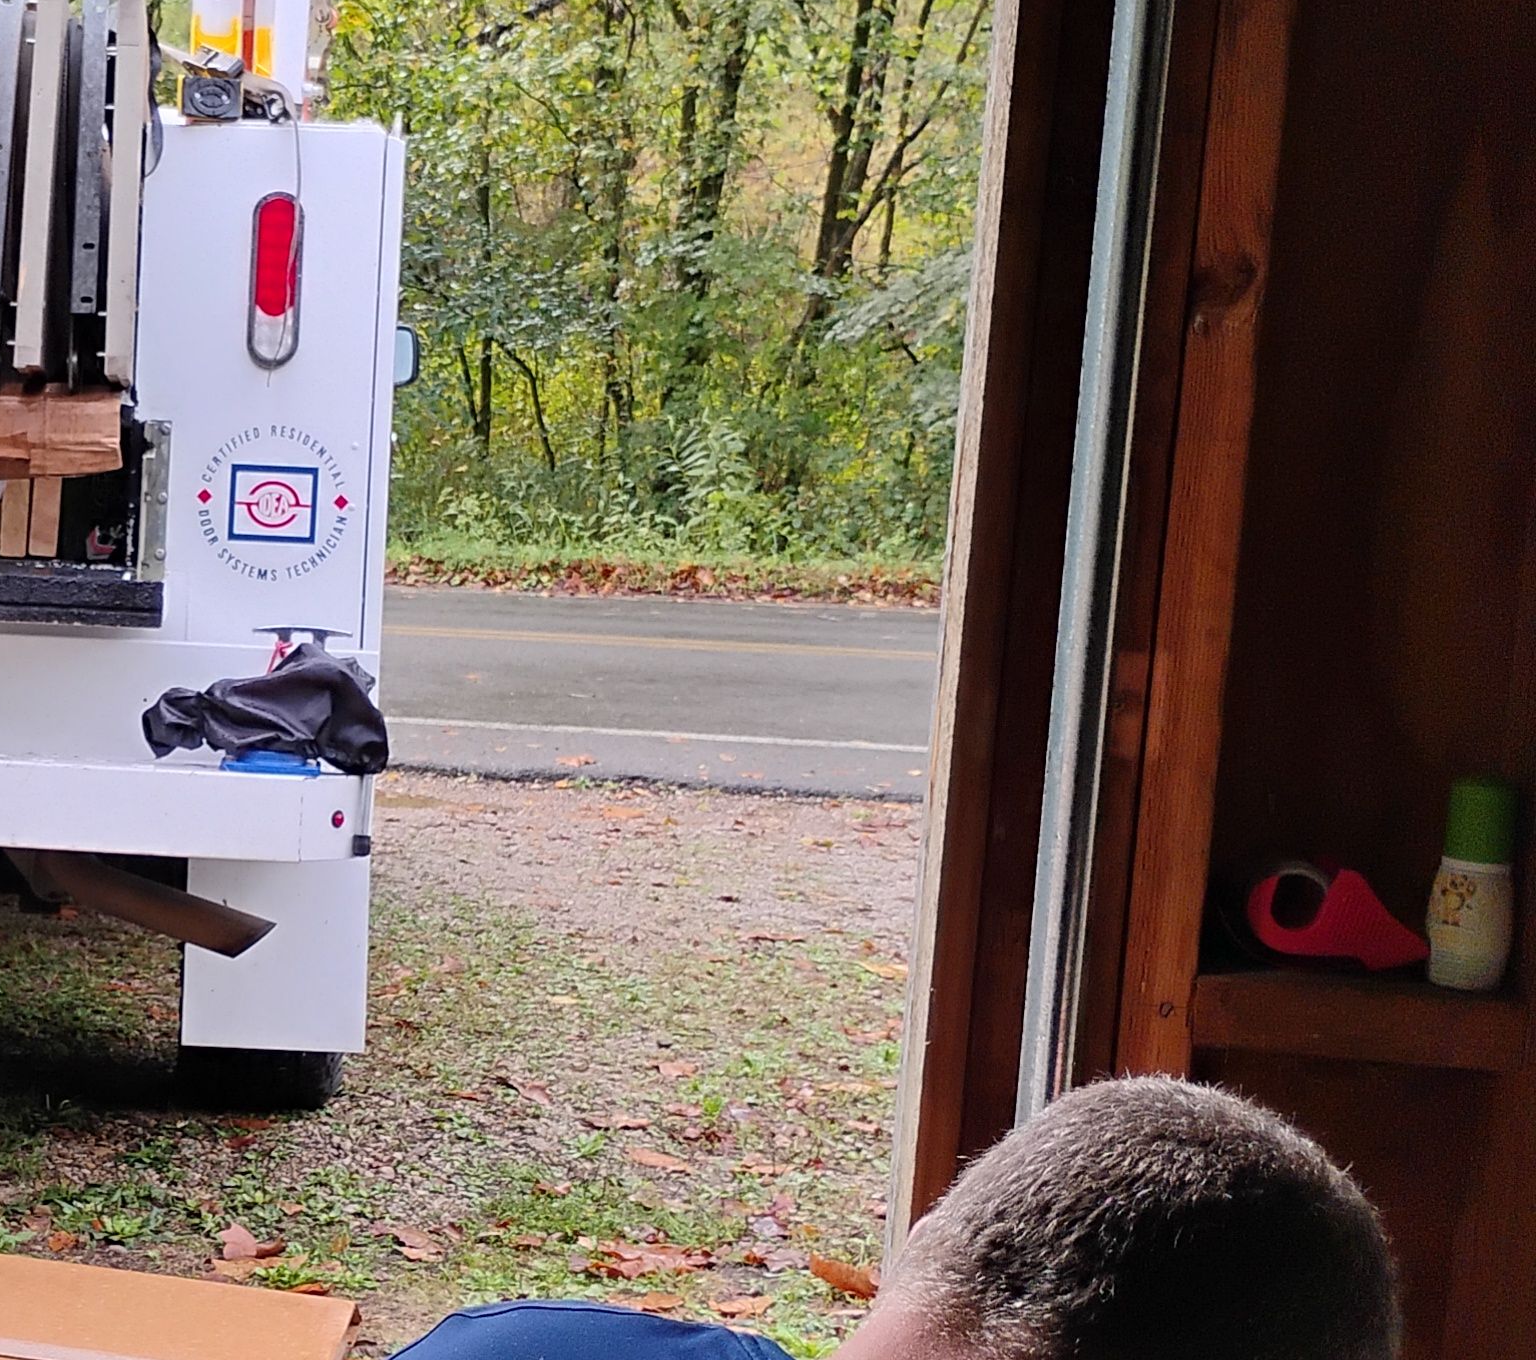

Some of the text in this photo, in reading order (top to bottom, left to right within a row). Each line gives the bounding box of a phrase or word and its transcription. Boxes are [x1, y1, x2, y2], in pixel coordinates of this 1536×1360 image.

[201, 425, 345, 489] CERTIFIED RESIDENTIAL
[198, 509, 348, 581] DOOR SYSTEMS TECHNICIAN
